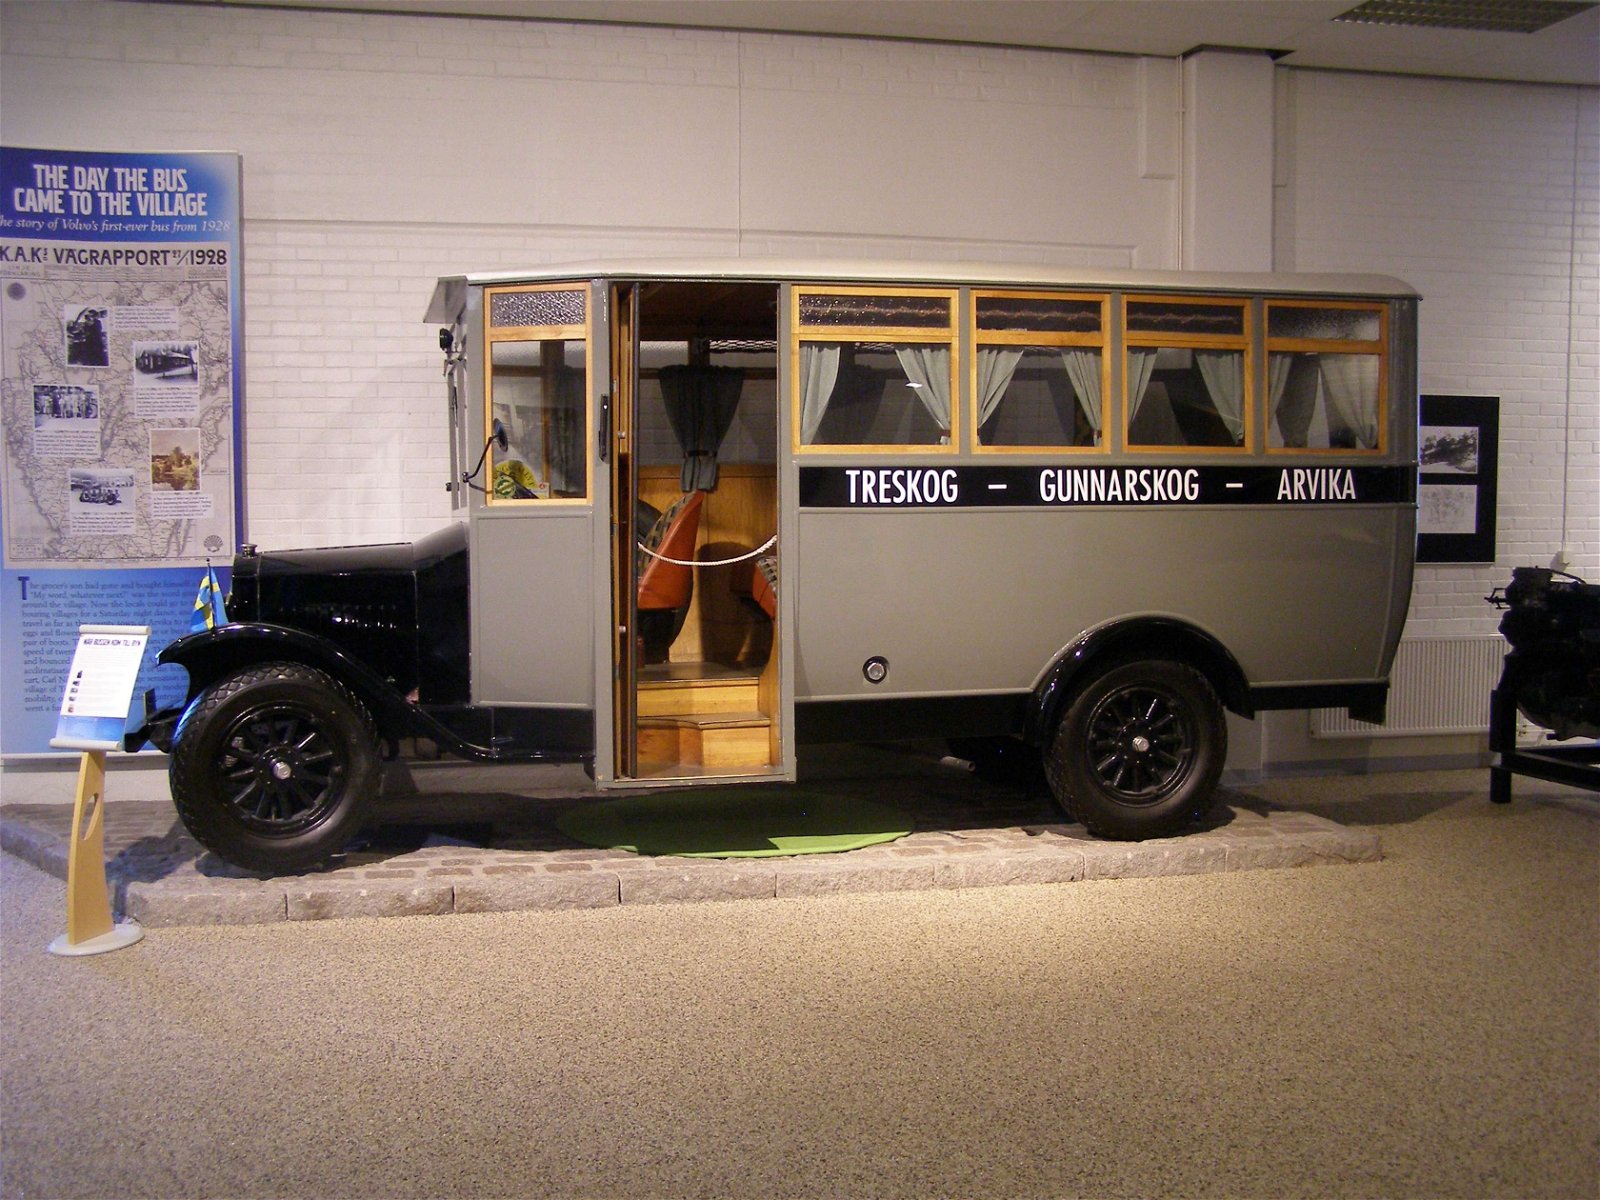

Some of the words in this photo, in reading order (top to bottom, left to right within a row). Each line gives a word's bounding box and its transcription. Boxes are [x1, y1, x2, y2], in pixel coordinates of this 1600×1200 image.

[33, 164, 69, 189] THE
[74, 166, 109, 191] DAY
[113, 167, 150, 191] THE
[153, 168, 188, 192] BUS
[14, 188, 65, 214] CAME
[69, 190, 93, 215] TO
[97, 191, 133, 216] THE
[137, 192, 208, 217] VILLAGE
[0, 215, 13, 227] he
[15, 218, 45, 231] story
[48, 217, 59, 229] of
[62, 218, 98, 231] Volvo's
[100, 219, 148, 232] first-ever
[151, 220, 169, 232] bus
[172, 219, 197, 233] from
[201, 220, 231, 231] 1928
[190, 249, 227, 265] 1928
[846, 469, 959, 504] TRESKOG
[1039, 468, 1200, 502] GUNNARSKOG
[1277, 469, 1357, 500] ARVIKA
[49, 600, 61, 608] the
[91, 600, 108, 608] Now
[111, 600, 123, 608] the
[80, 609, 91, 618] for
[22, 618, 43, 628] travel
[53, 618, 64, 628] far
[22, 630, 38, 639] eggs
[40, 629, 54, 637] and
[39, 637, 47, 647] of
[23, 647, 44, 658] speed
[46, 647, 54, 656] of
[23, 656, 38, 665] and
[39, 656, 71, 665] bounced
[41, 676, 56, 684] Carl
[24, 685, 47, 695] village
[49, 685, 57, 693] of
